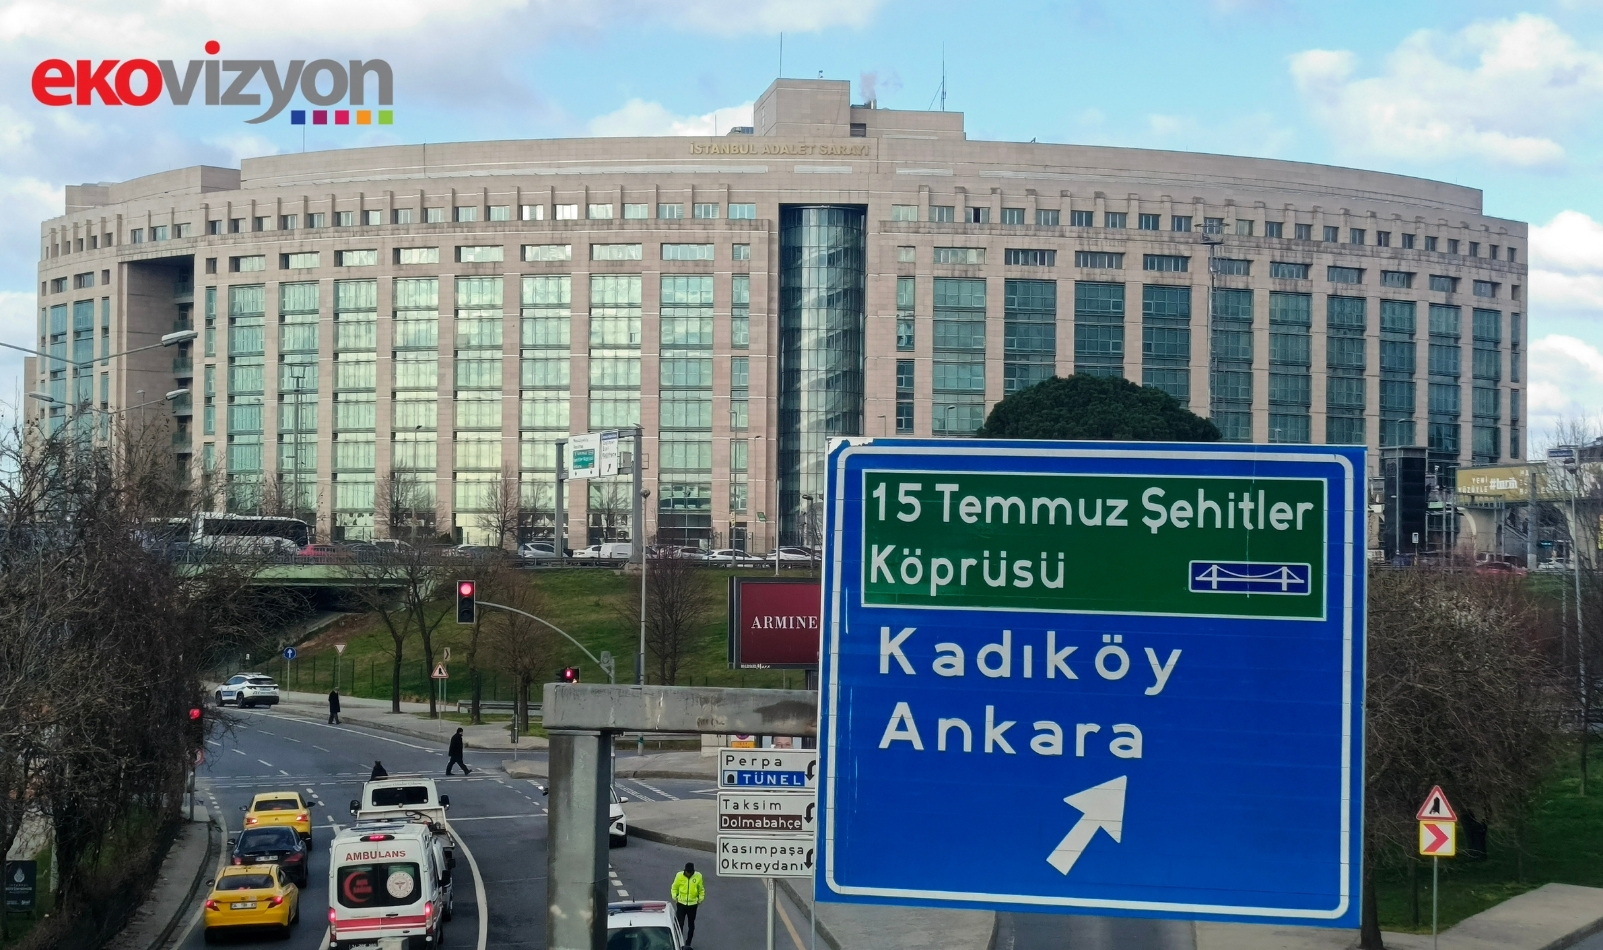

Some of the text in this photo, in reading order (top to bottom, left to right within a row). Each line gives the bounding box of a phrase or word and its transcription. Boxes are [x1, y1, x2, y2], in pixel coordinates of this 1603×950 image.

[689, 141, 870, 157] İSTANBUL ADALET SARAYI
[872, 482, 1314, 534] 15 Temmuz Şehitler
[870, 544, 1065, 597] Köprüsü
[751, 616, 818, 629] ARMINE
[878, 626, 1182, 696] Kadıköy
[878, 702, 1143, 759] Ankara
[726, 755, 782, 769] Perpa
[742, 772, 801, 785] TÜNEL
[722, 799, 781, 811] Taksim
[721, 816, 801, 830] Dolmabahçe
[345, 850, 406, 862] AMBULANS
[722, 842, 804, 858] Kasımpaşa
[721, 858, 803, 873] Okmeydanı
